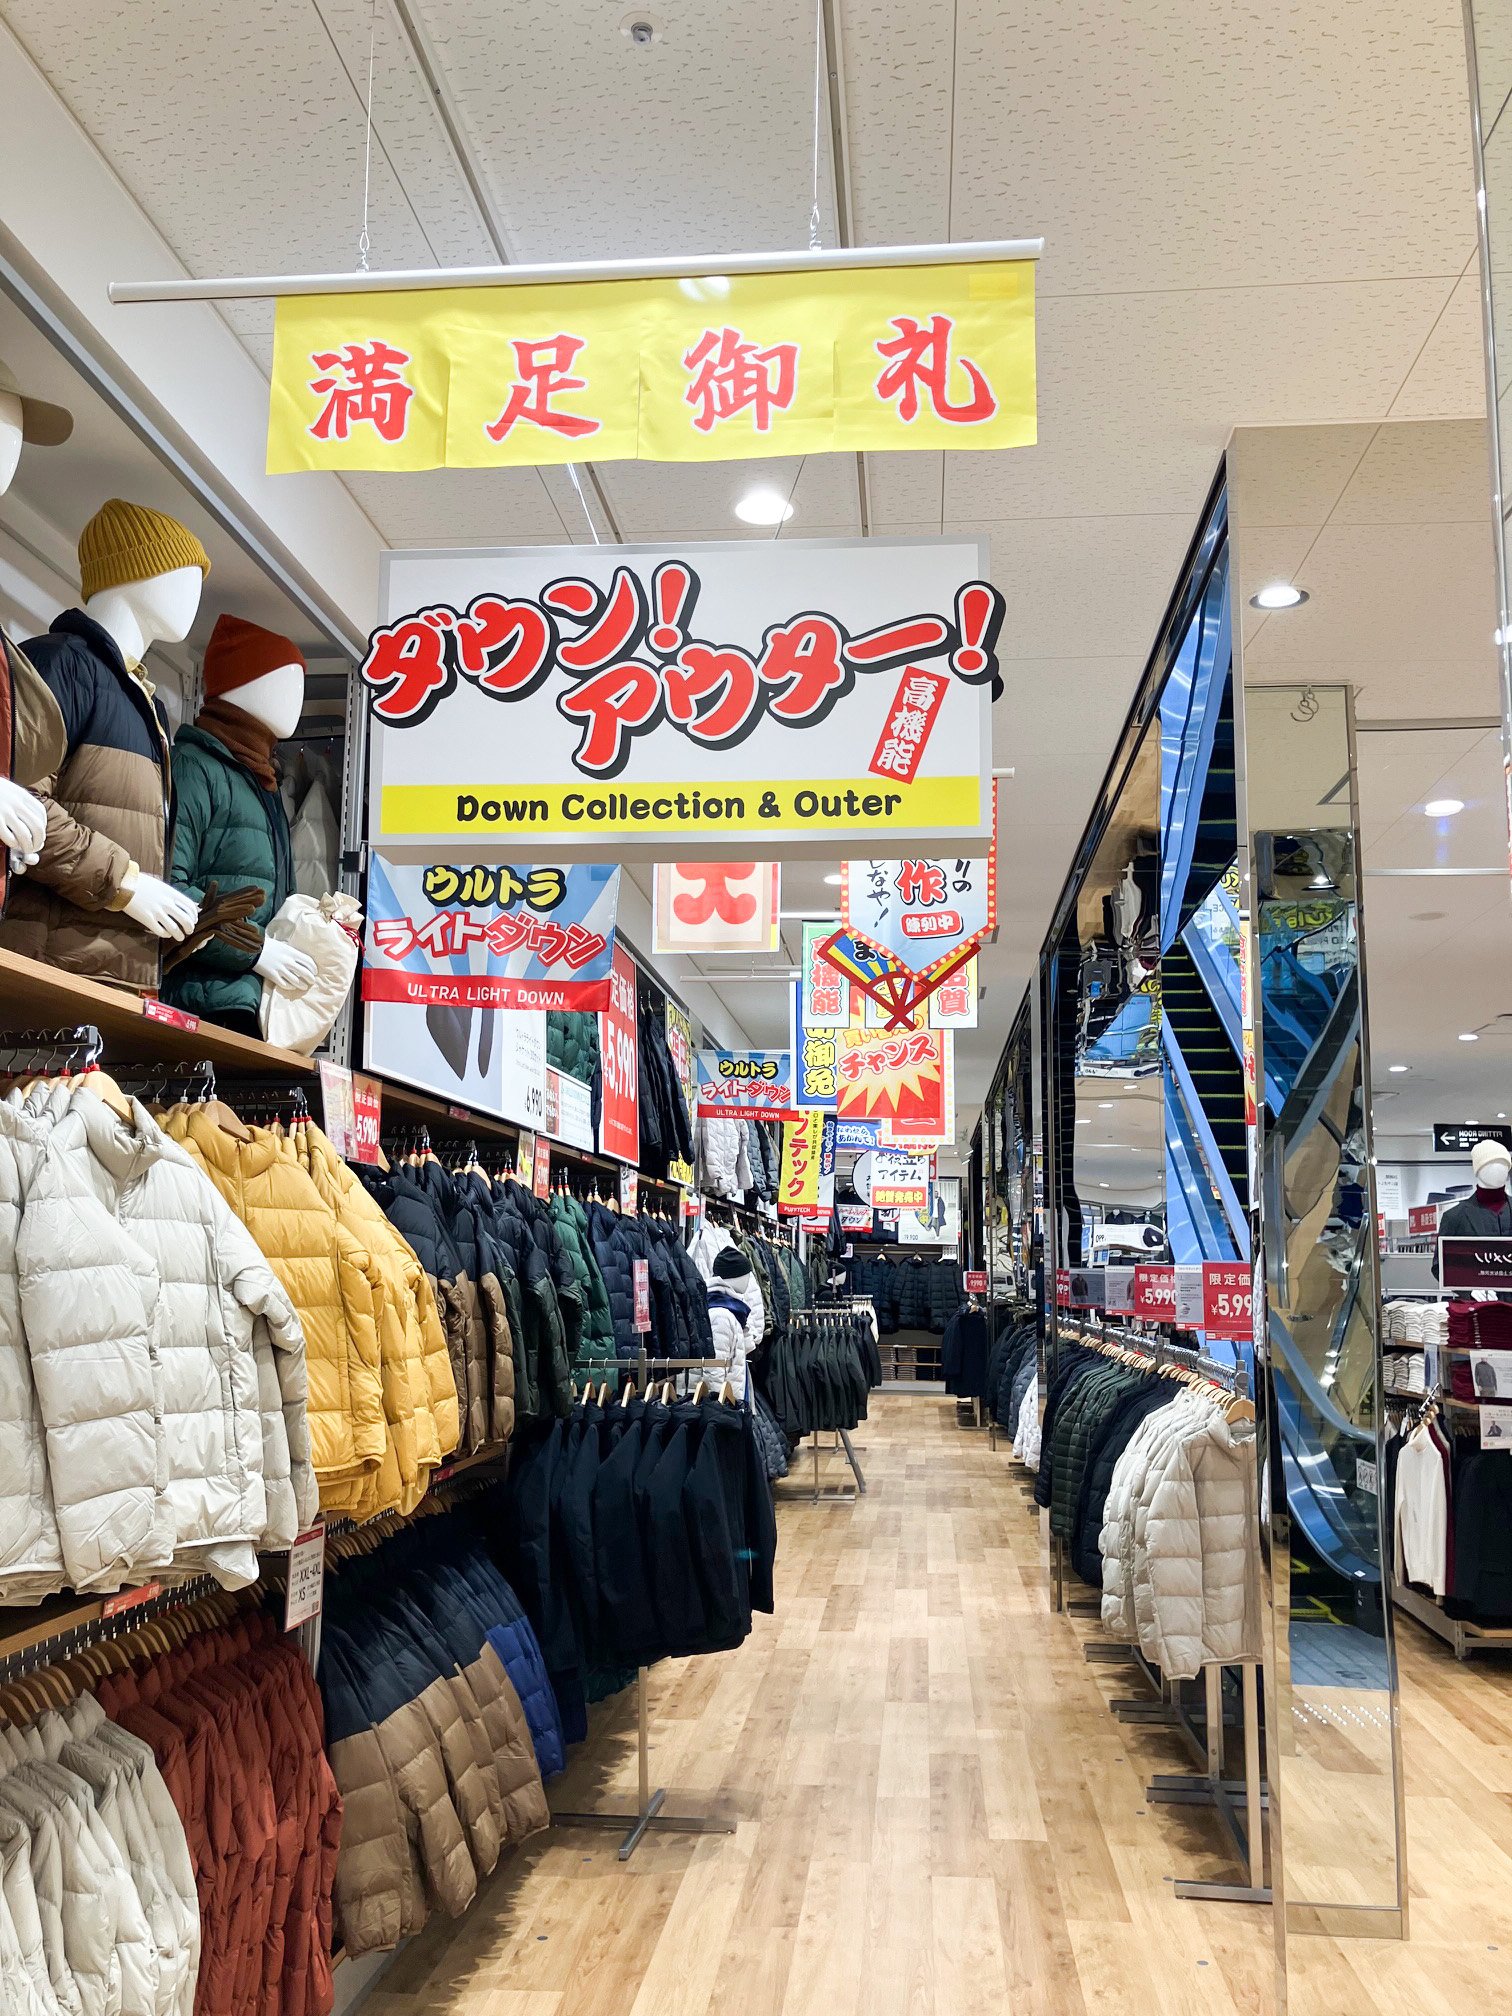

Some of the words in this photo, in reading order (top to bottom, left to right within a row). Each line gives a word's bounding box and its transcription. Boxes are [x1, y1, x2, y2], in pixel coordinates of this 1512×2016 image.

[876, 675, 935, 776] 高機能
[456, 793, 549, 823] Down
[561, 791, 745, 821] Collection
[759, 792, 781, 819] &
[794, 789, 902, 819] Outer
[425, 865, 564, 911] ウルトラ
[374, 911, 606, 969] ライトダウン
[407, 982, 460, 1000] ULTRA
[466, 986, 511, 1002] LIGHT
[517, 989, 565, 1005] DOWN
[719, 1060, 779, 1079] ウルトラ
[840, 1033, 938, 1081] チャンス
[716, 1109, 739, 1117] ULTRA
[740, 1110, 759, 1118] LIGHT
[760, 1111, 780, 1119] DOWN
[878, 1169, 922, 1182] アイテム
[1209, 1273, 1251, 1286] 限定価
